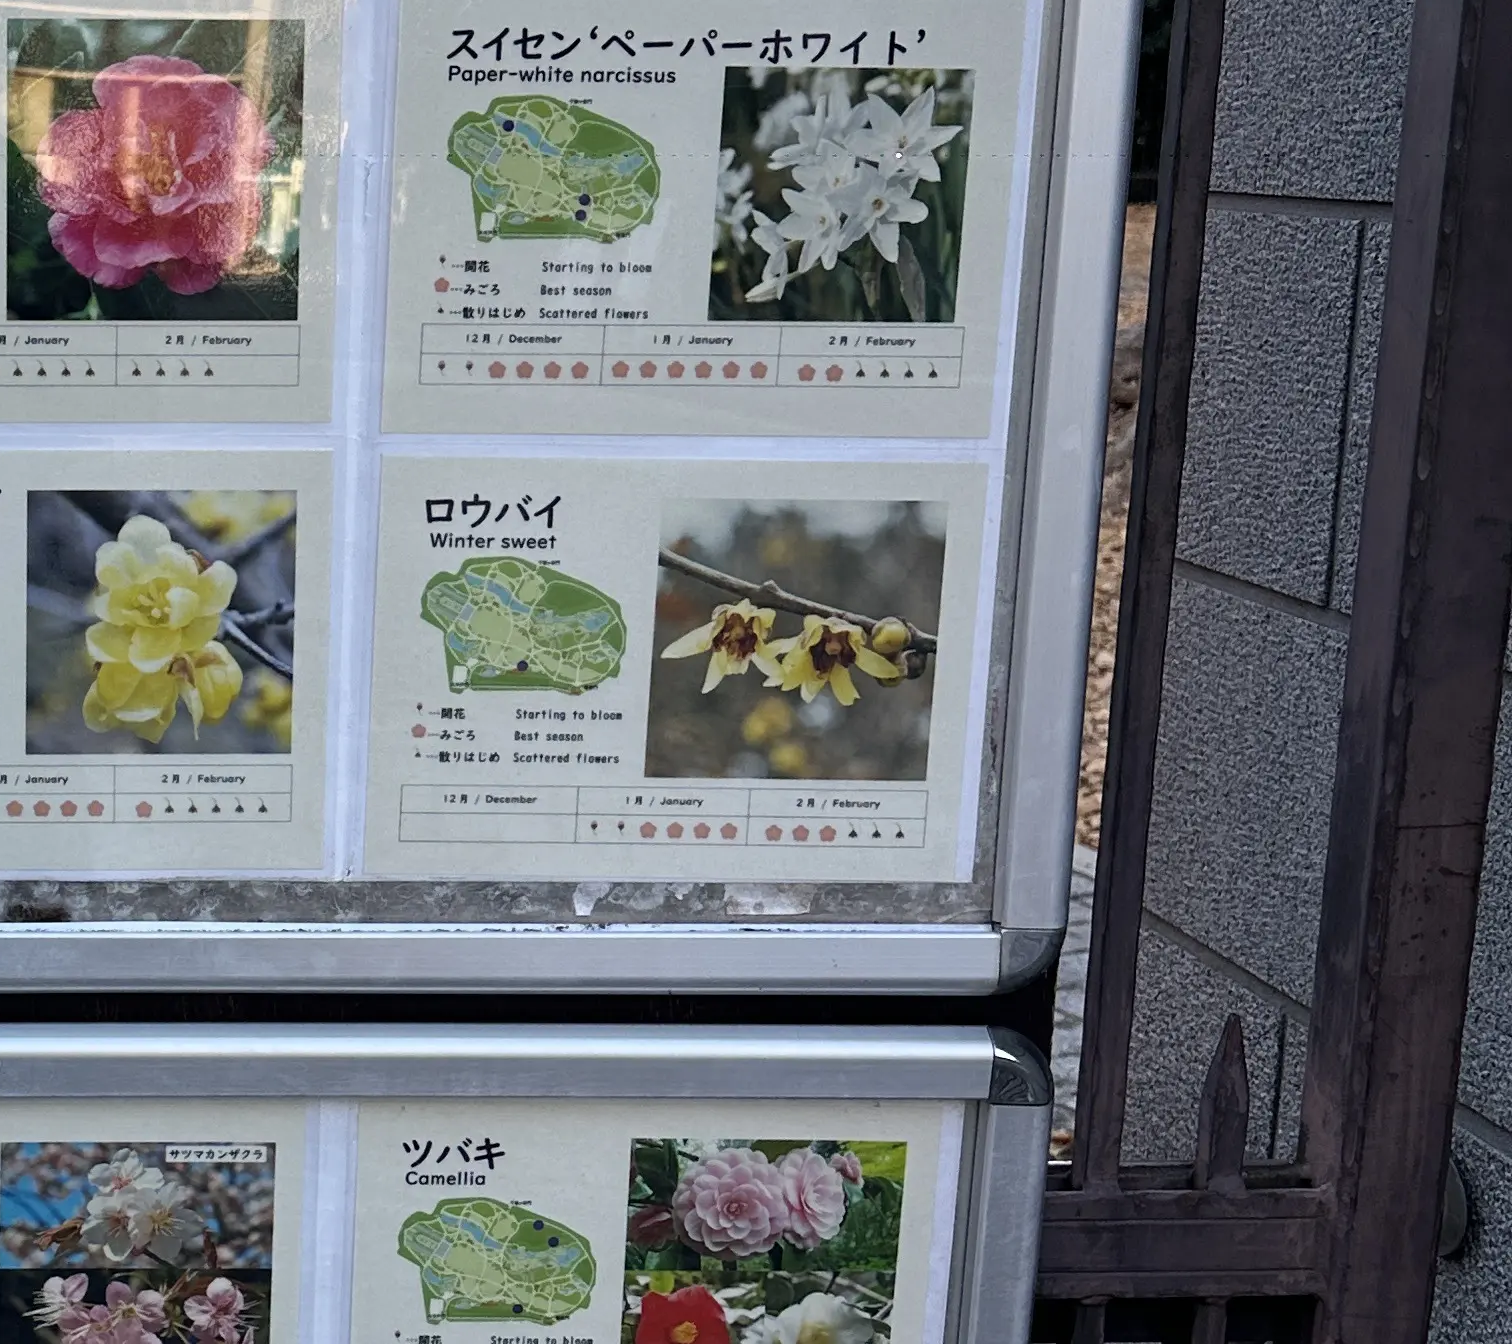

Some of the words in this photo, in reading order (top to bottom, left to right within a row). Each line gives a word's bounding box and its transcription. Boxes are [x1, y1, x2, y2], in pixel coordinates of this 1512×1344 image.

[448, 65, 574, 86] Paper-white
[580, 66, 676, 84] narcissus
[425, 493, 562, 529] ロウバイ
[429, 532, 496, 549] Winter
[500, 535, 557, 550] sweet
[24, 774, 69, 786] January
[197, 774, 246, 785] February
[168, 1148, 263, 1160] サツマカンザクラ
[402, 1137, 506, 1170] ツバキ
[405, 1170, 486, 1186] Camellia
